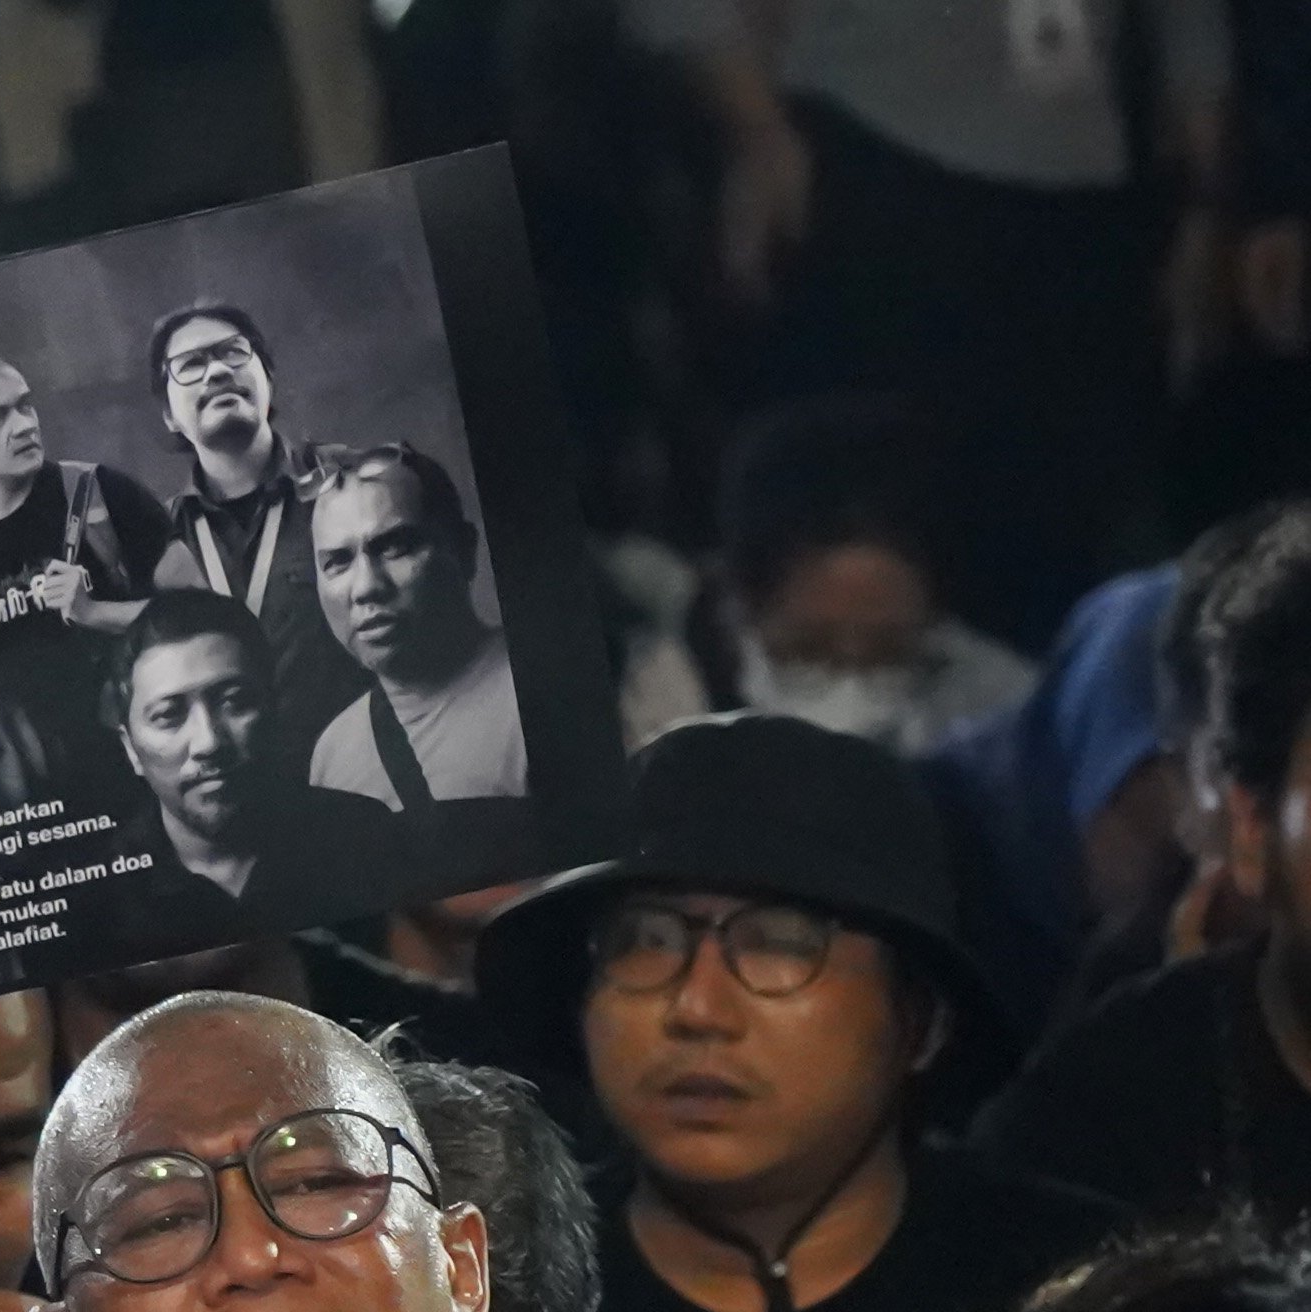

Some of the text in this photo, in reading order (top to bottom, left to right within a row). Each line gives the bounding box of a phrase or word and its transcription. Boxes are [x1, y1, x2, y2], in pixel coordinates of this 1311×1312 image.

[26, 814, 118, 846] sesama.
[39, 863, 108, 891] dalam
[111, 853, 154, 875] doa
